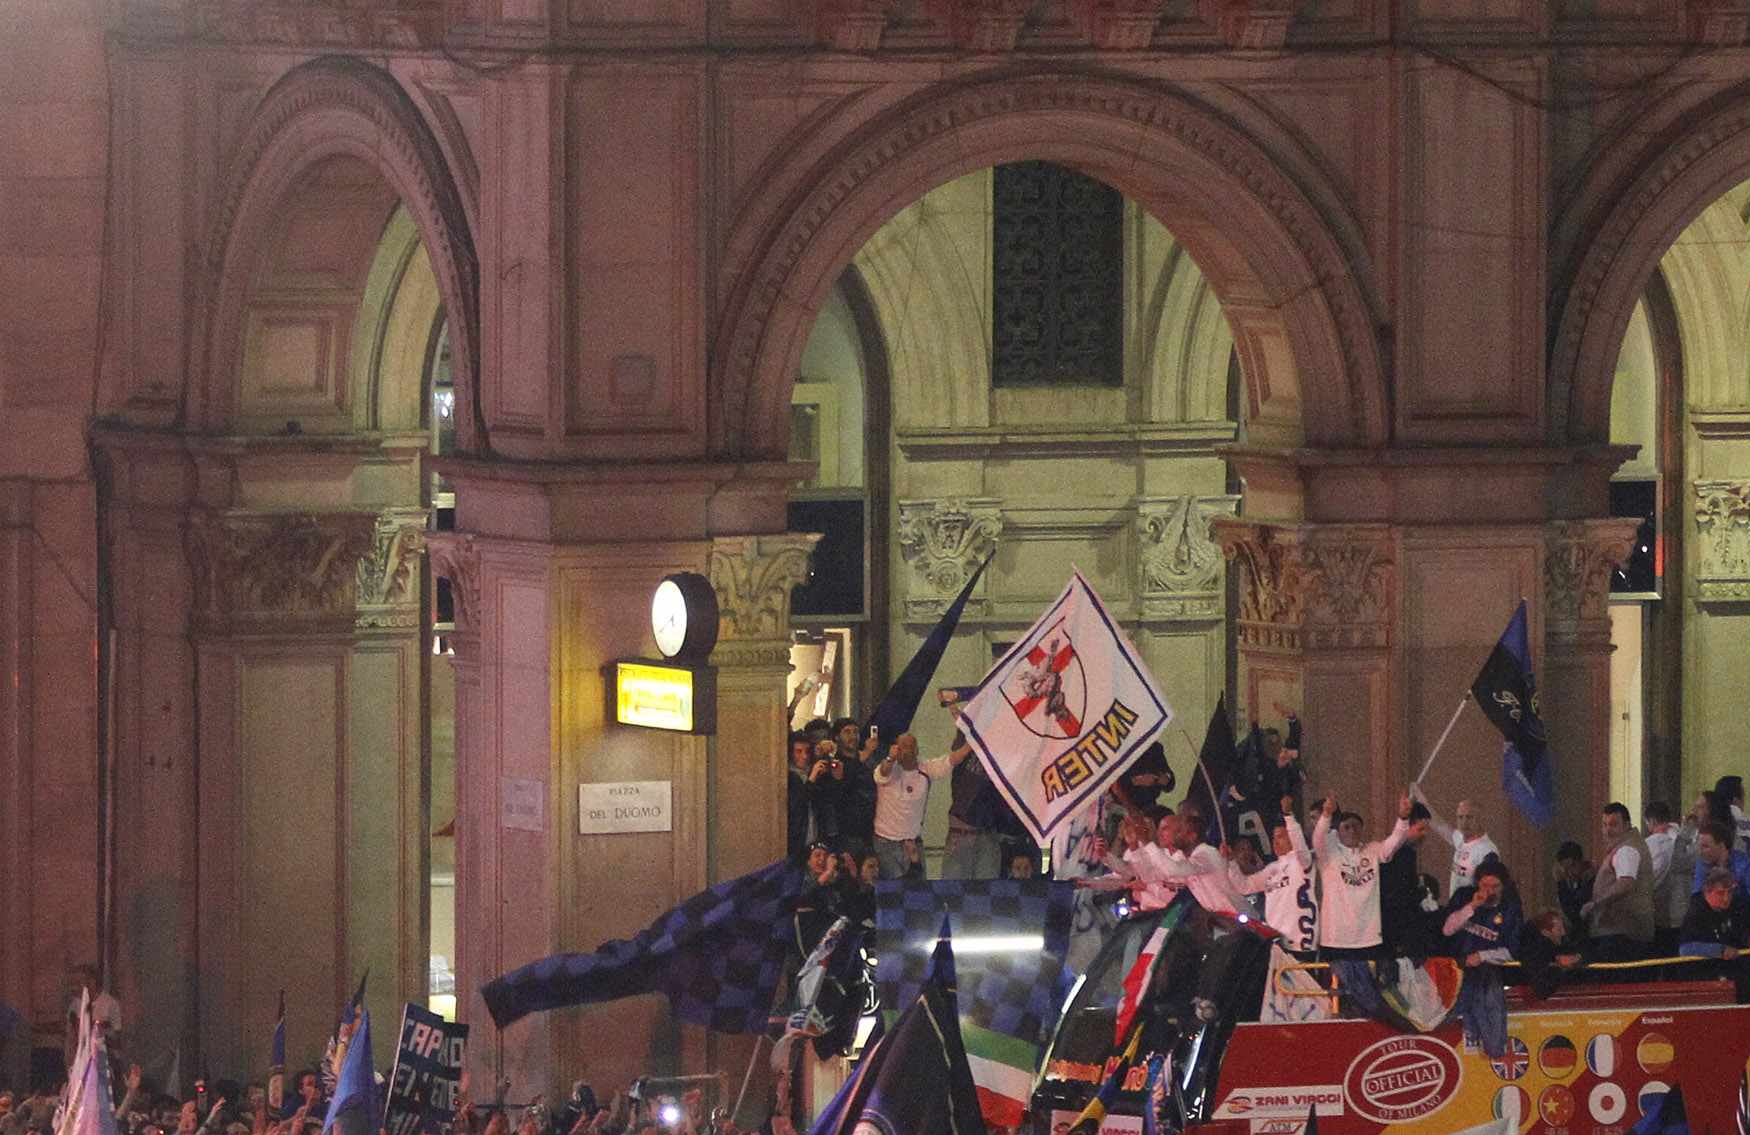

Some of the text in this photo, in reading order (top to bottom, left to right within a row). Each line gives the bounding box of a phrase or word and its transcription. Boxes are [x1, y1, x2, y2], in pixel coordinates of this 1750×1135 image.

[608, 786, 641, 796] PIAZZA
[589, 806, 662, 820] DEL DUOMO
[1380, 1038, 1417, 1055] TOUR
[1366, 1066, 1440, 1094] OFFICIAL
[1254, 1093, 1342, 1106] ZANI VIAGGI
[1377, 1094, 1442, 1120] OF MILANO
